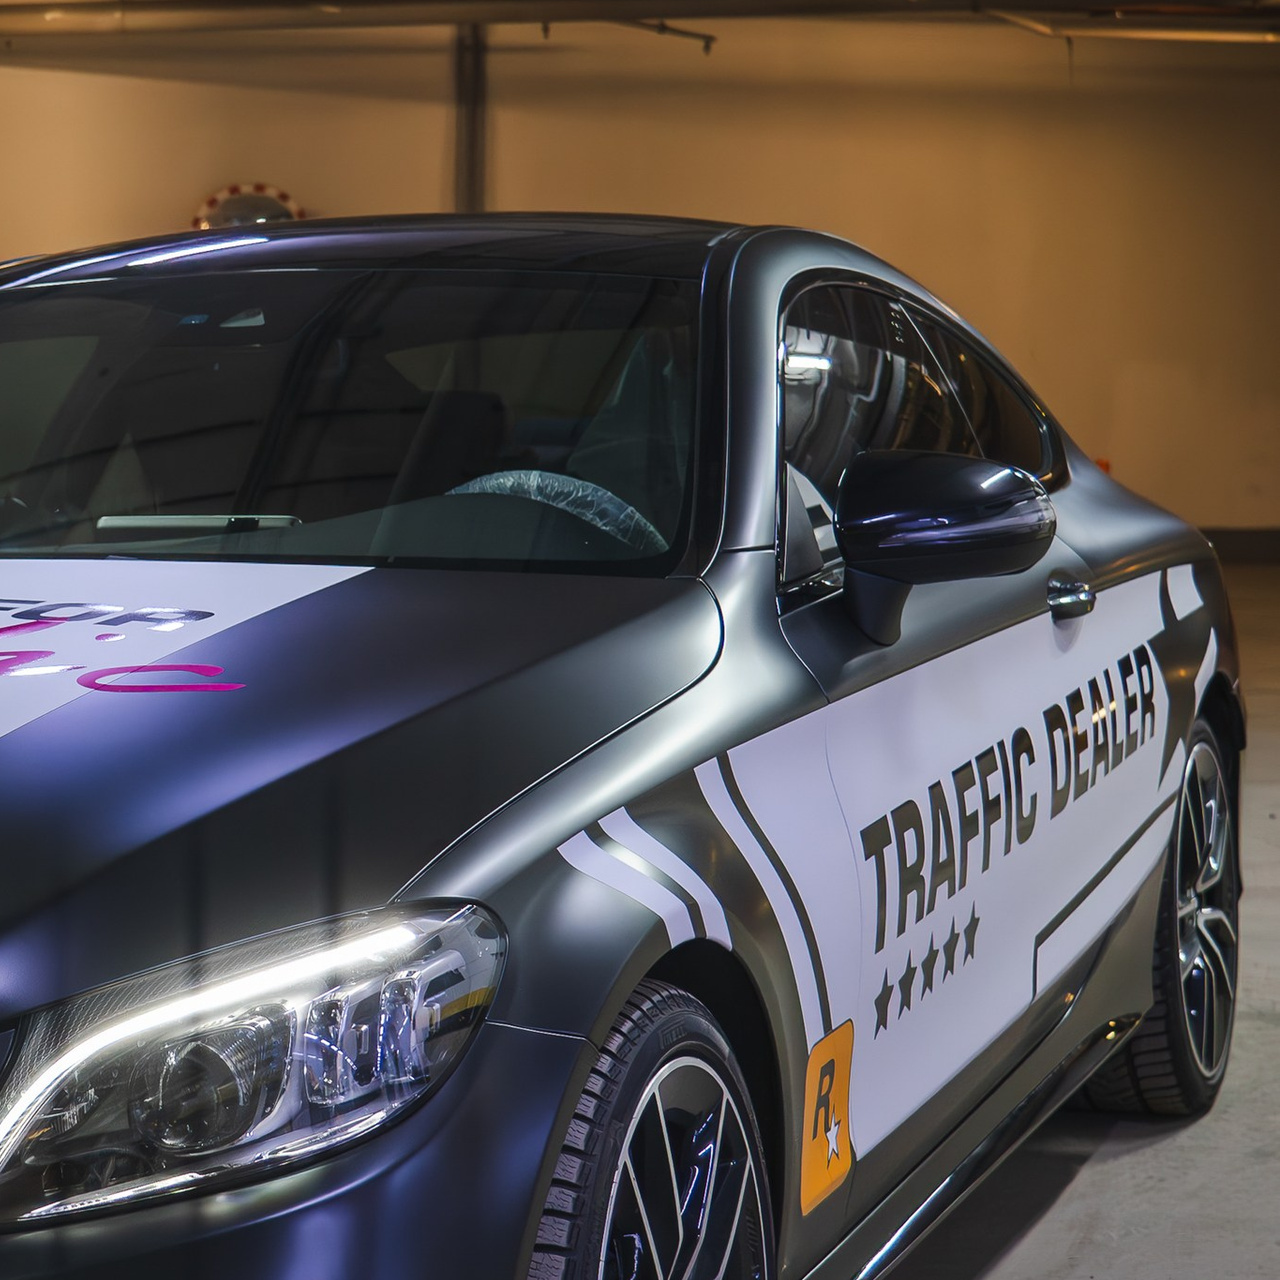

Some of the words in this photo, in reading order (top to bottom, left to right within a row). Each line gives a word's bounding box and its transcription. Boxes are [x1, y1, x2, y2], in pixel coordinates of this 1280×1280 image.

[860, 726, 1038, 955] TRAFFIC
[1042, 643, 1156, 821] DEALER
[811, 1056, 836, 1142] R
